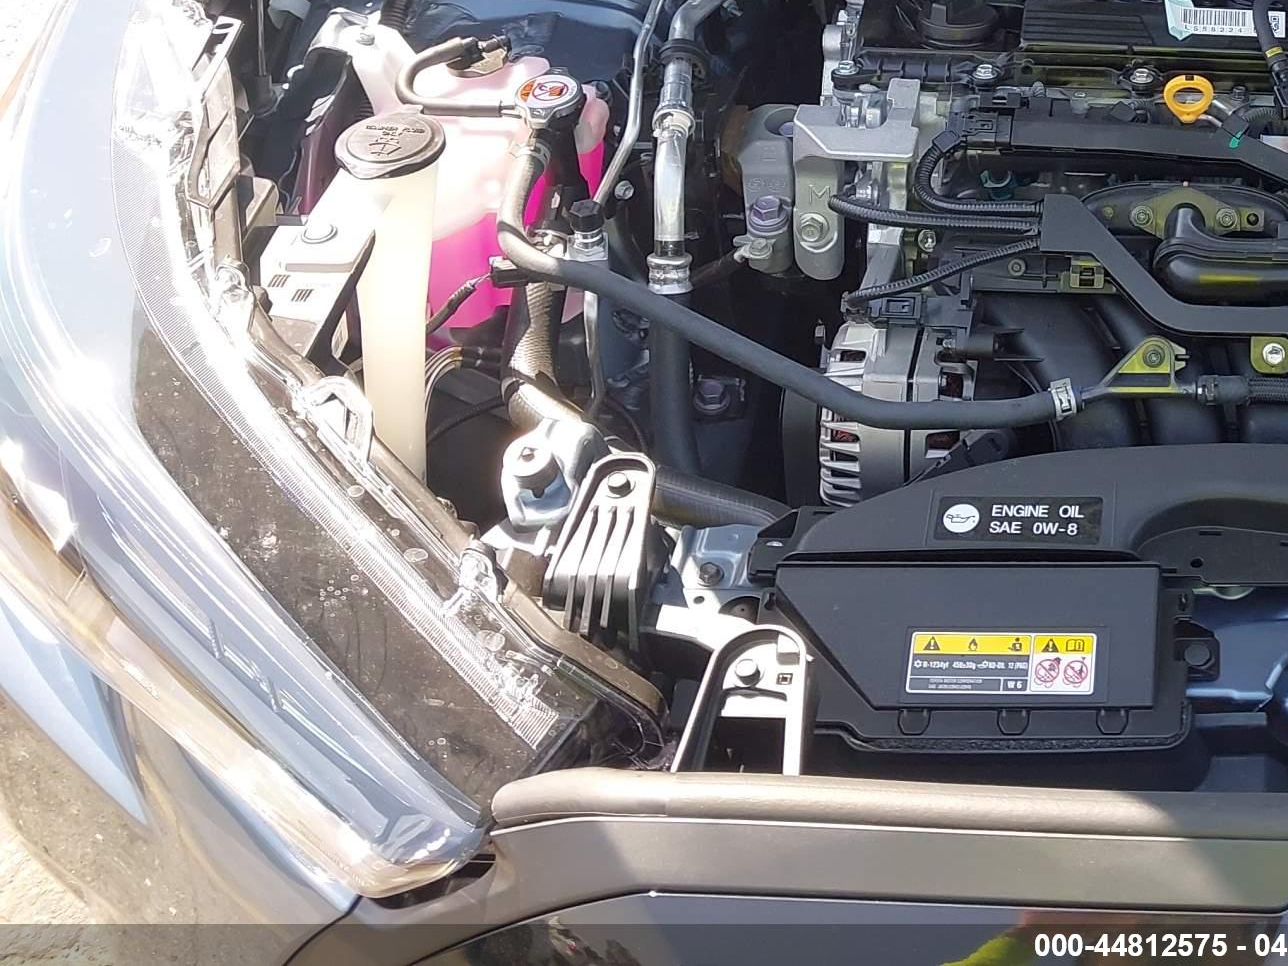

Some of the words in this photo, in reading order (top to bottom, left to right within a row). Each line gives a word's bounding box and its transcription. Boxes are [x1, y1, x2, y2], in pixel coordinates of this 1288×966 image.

[991, 504, 1050, 518] ENGINE
[1059, 505, 1085, 518] OIL
[989, 521, 1022, 534] SAE
[1032, 522, 1078, 535] 0W-8
